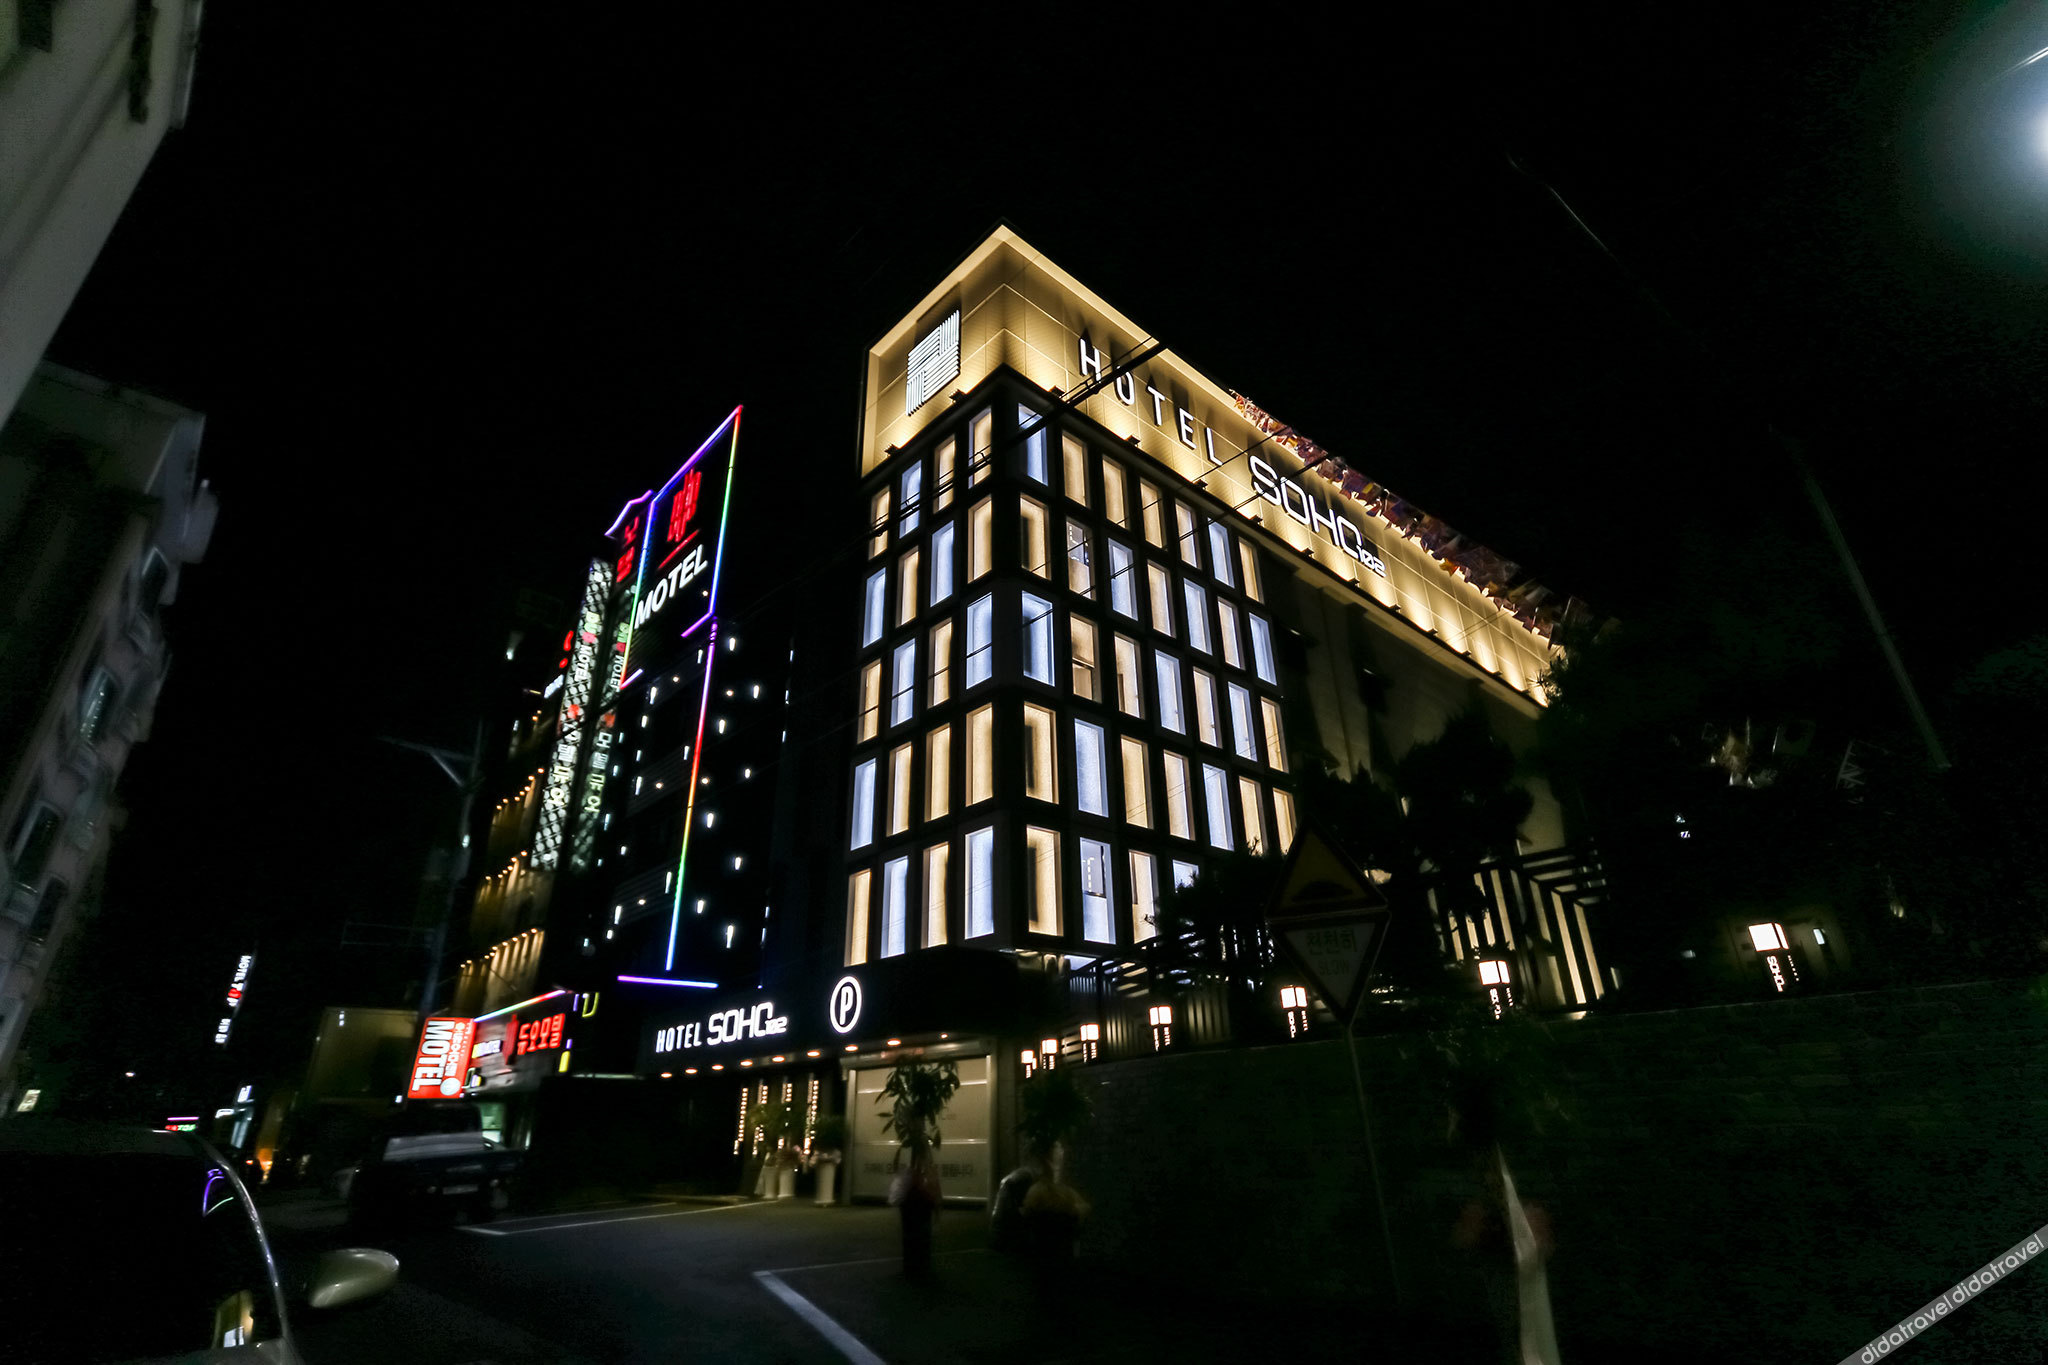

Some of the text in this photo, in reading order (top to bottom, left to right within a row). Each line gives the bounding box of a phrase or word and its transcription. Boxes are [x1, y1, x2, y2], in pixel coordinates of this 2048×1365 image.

[1078, 337, 1224, 466] HOTEL
[634, 543, 709, 630] MOTEL
[575, 643, 594, 682] MOTEL
[233, 954, 252, 981] MOTEL
[411, 1019, 456, 1092] MOTEL
[655, 1021, 702, 1053] HOTEL
